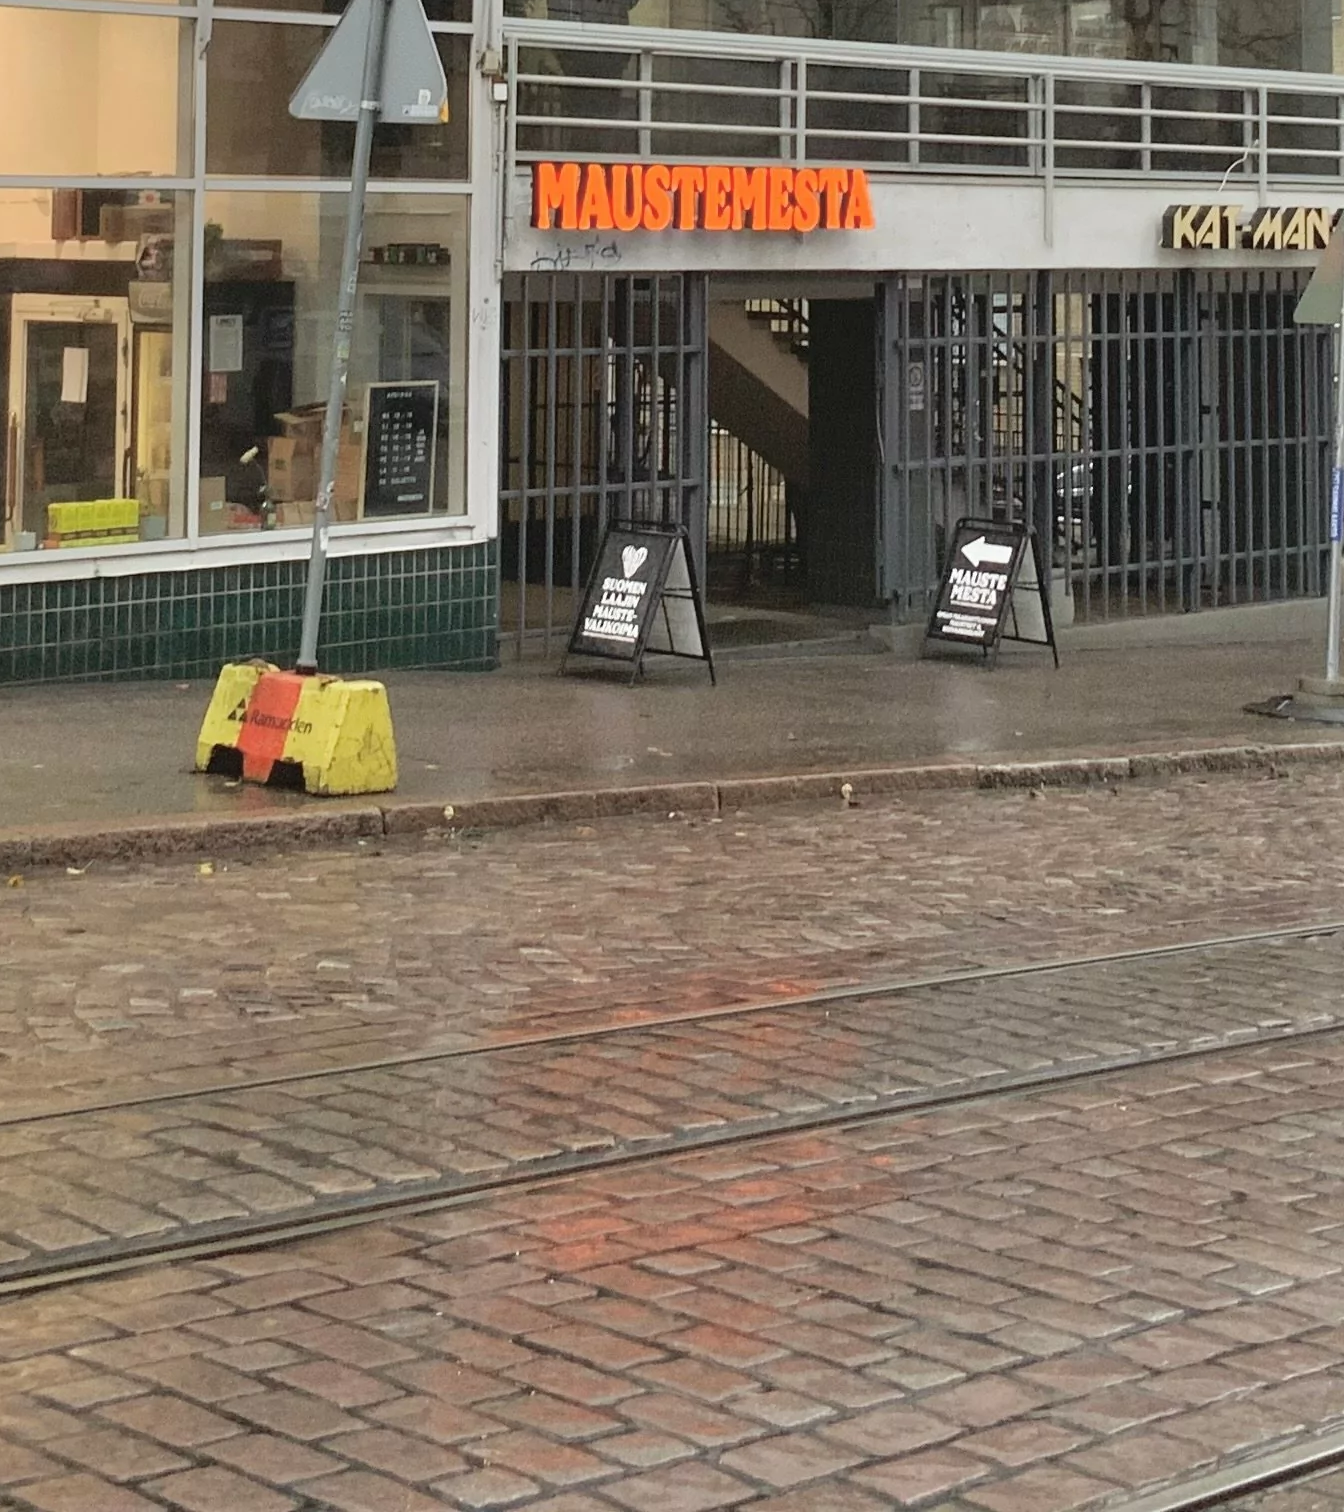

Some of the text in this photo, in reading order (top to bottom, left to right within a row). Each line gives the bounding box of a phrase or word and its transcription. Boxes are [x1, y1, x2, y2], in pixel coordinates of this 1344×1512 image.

[531, 162, 876, 232] MAUSTEMESTA
[602, 577, 647, 596] SUOMEN
[949, 568, 1008, 592] MAUSTE
[601, 591, 640, 609] LAAJIN
[950, 584, 996, 605] MESTA
[592, 604, 638, 623] MAUSTE-
[584, 617, 639, 639] VALIKOIMA
